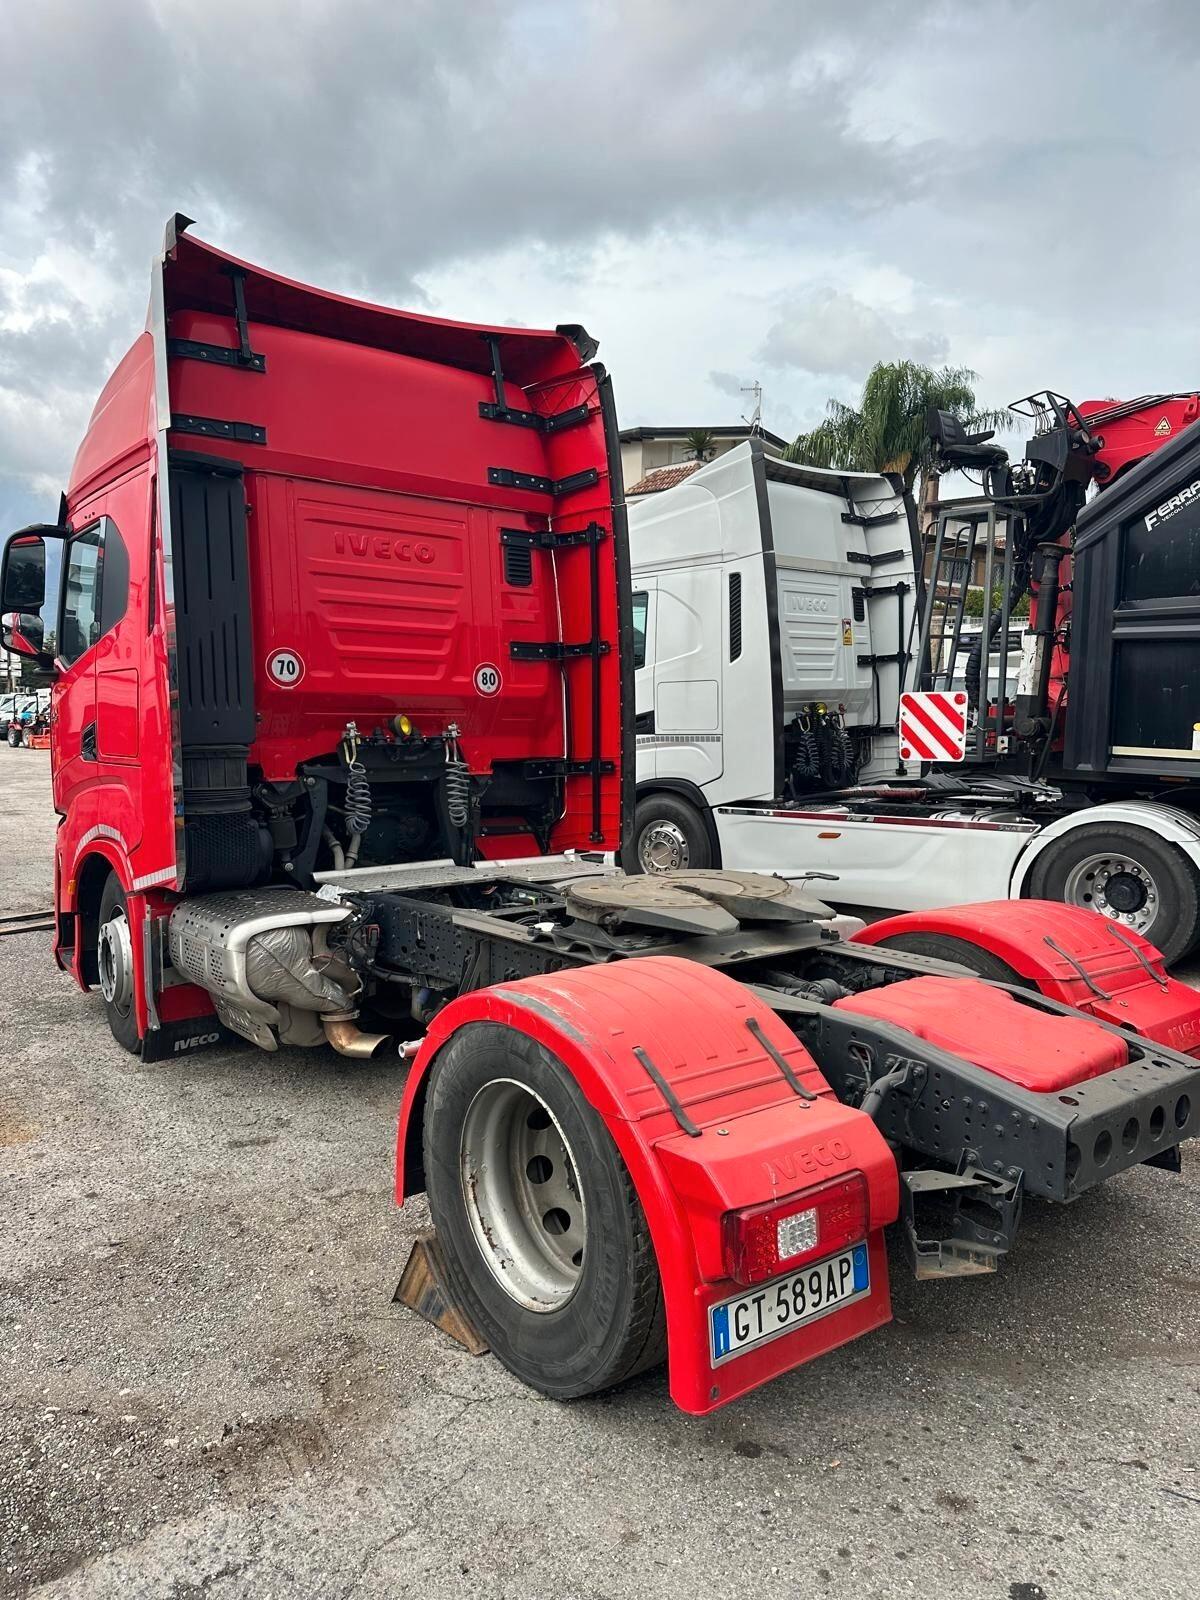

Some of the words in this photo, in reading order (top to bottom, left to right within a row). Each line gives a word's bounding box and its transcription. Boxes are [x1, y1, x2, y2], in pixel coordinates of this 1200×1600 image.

[333, 531, 436, 564] IVECO
[792, 596, 829, 612] IVECO
[277, 659, 296, 676] 70
[481, 672, 496, 687] 80
[174, 1032, 220, 1051] IVECO
[1167, 1018, 1200, 1049] IVEC
[761, 1137, 852, 1185] IVECO
[734, 1294, 766, 1342] GT
[776, 1257, 851, 1324] 589AP
